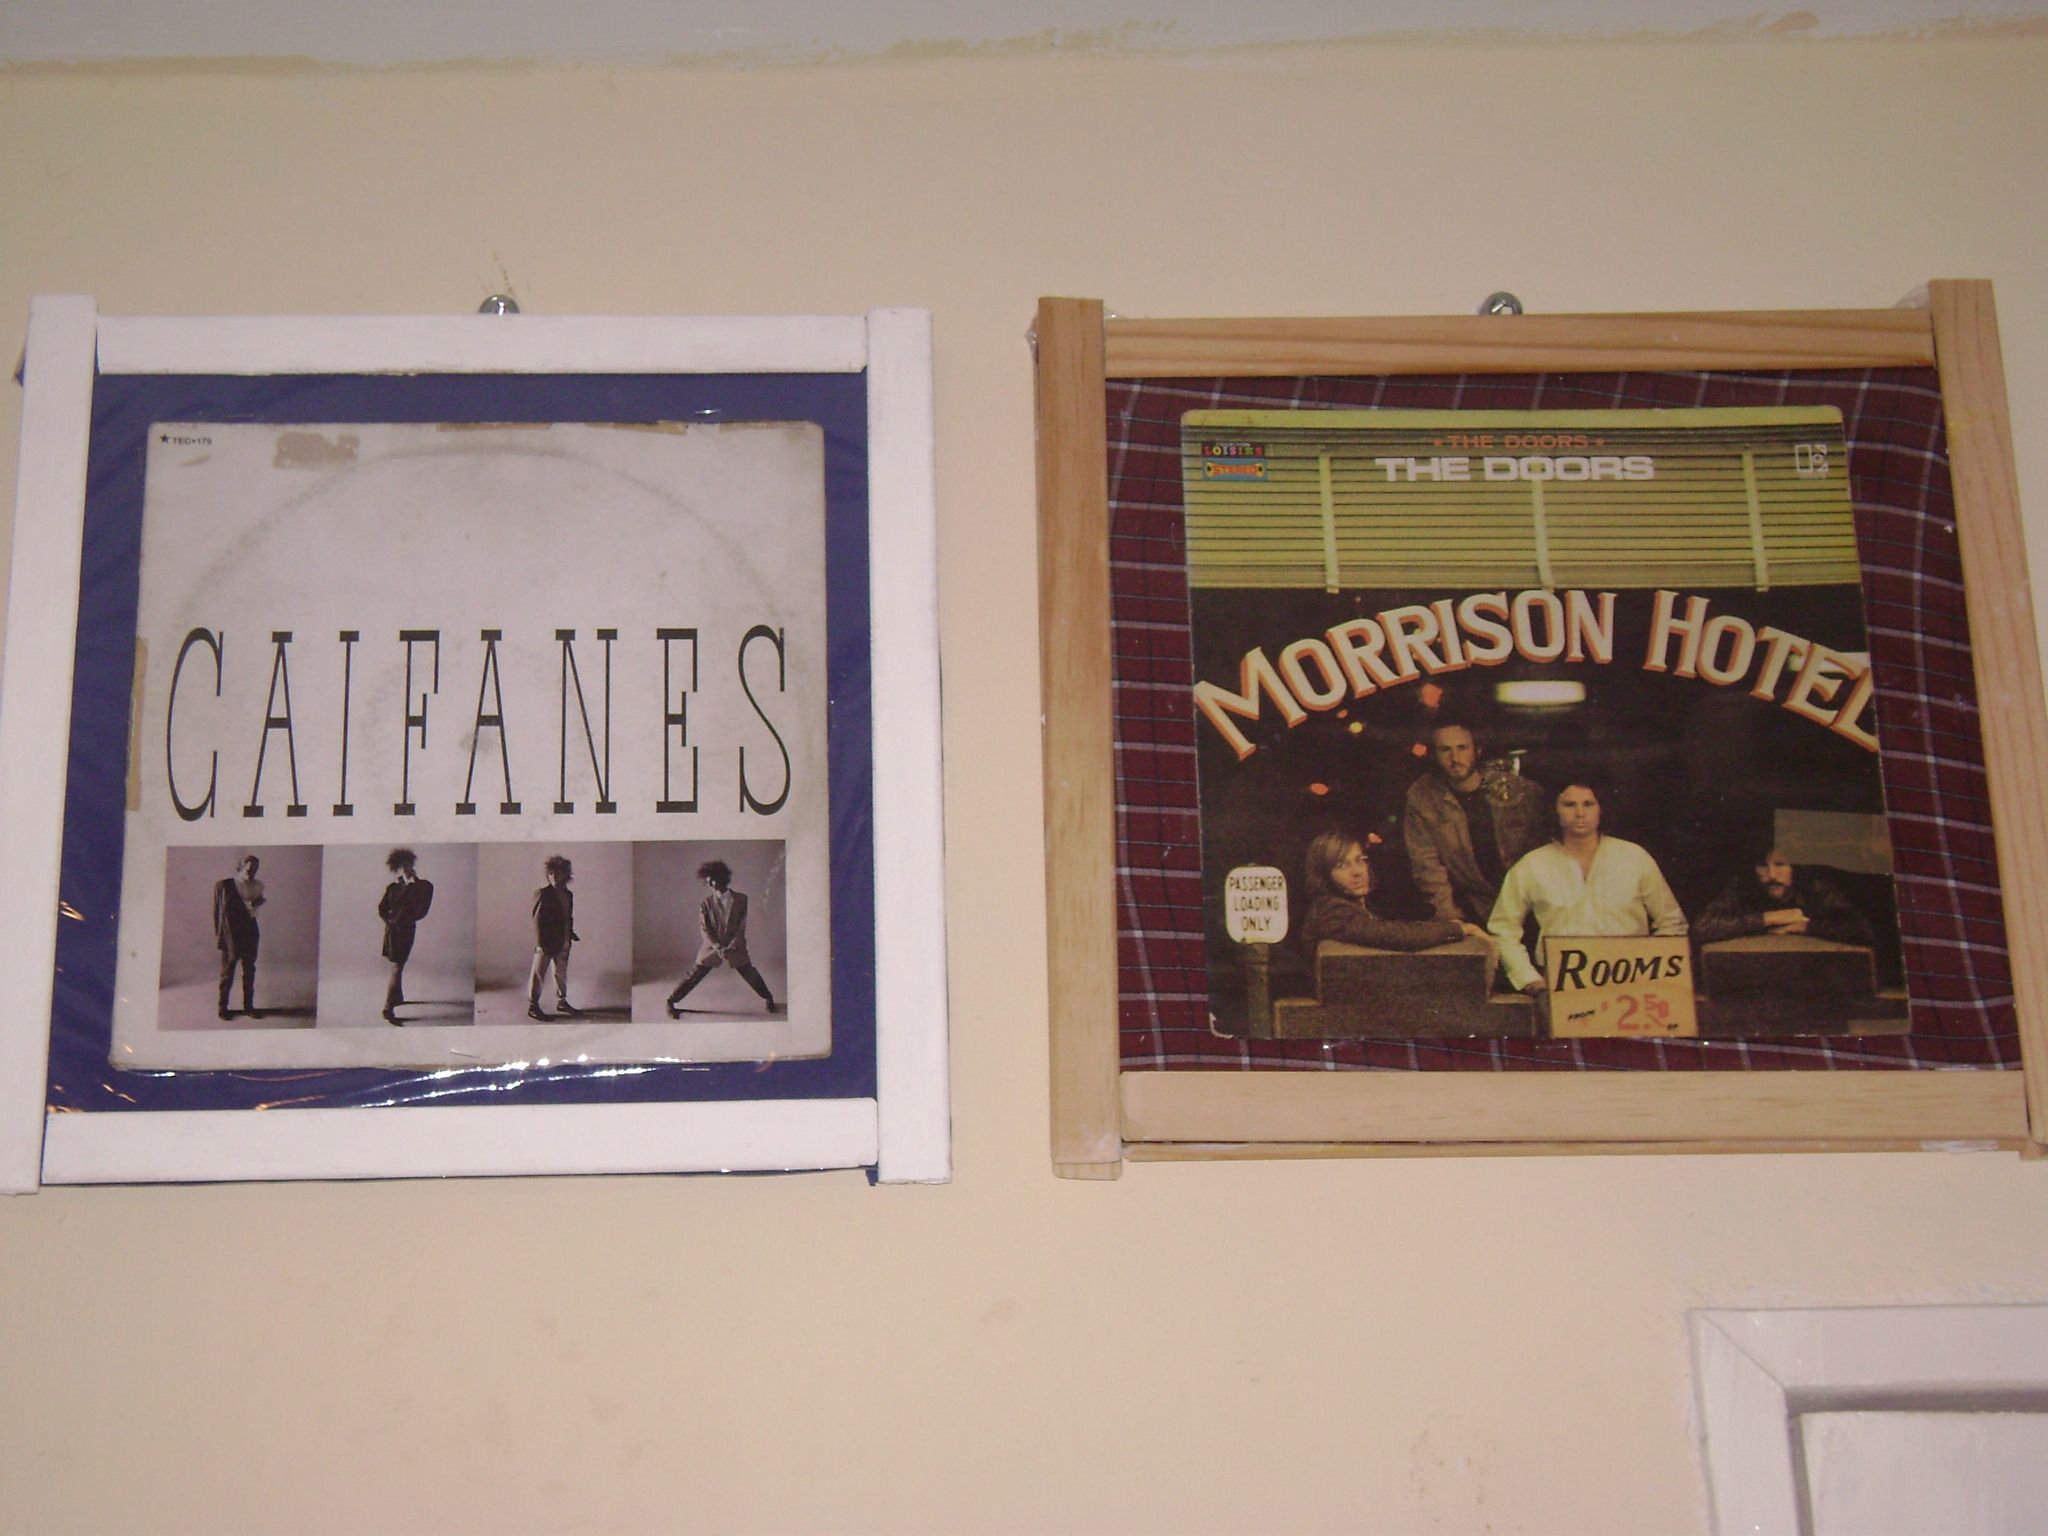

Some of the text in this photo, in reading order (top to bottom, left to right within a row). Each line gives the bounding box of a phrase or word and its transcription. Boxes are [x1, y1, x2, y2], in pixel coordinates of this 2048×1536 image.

[1447, 435, 1589, 448] THE DOORS
[1375, 456, 1655, 481] THE DOORS
[1194, 589, 1880, 760] MORRISON HOTEL
[166, 624, 792, 823] CAIFANES
[1229, 876, 1283, 891] PASSENGER
[1234, 896, 1280, 911] LOADING
[1242, 916, 1271, 931] ONLY
